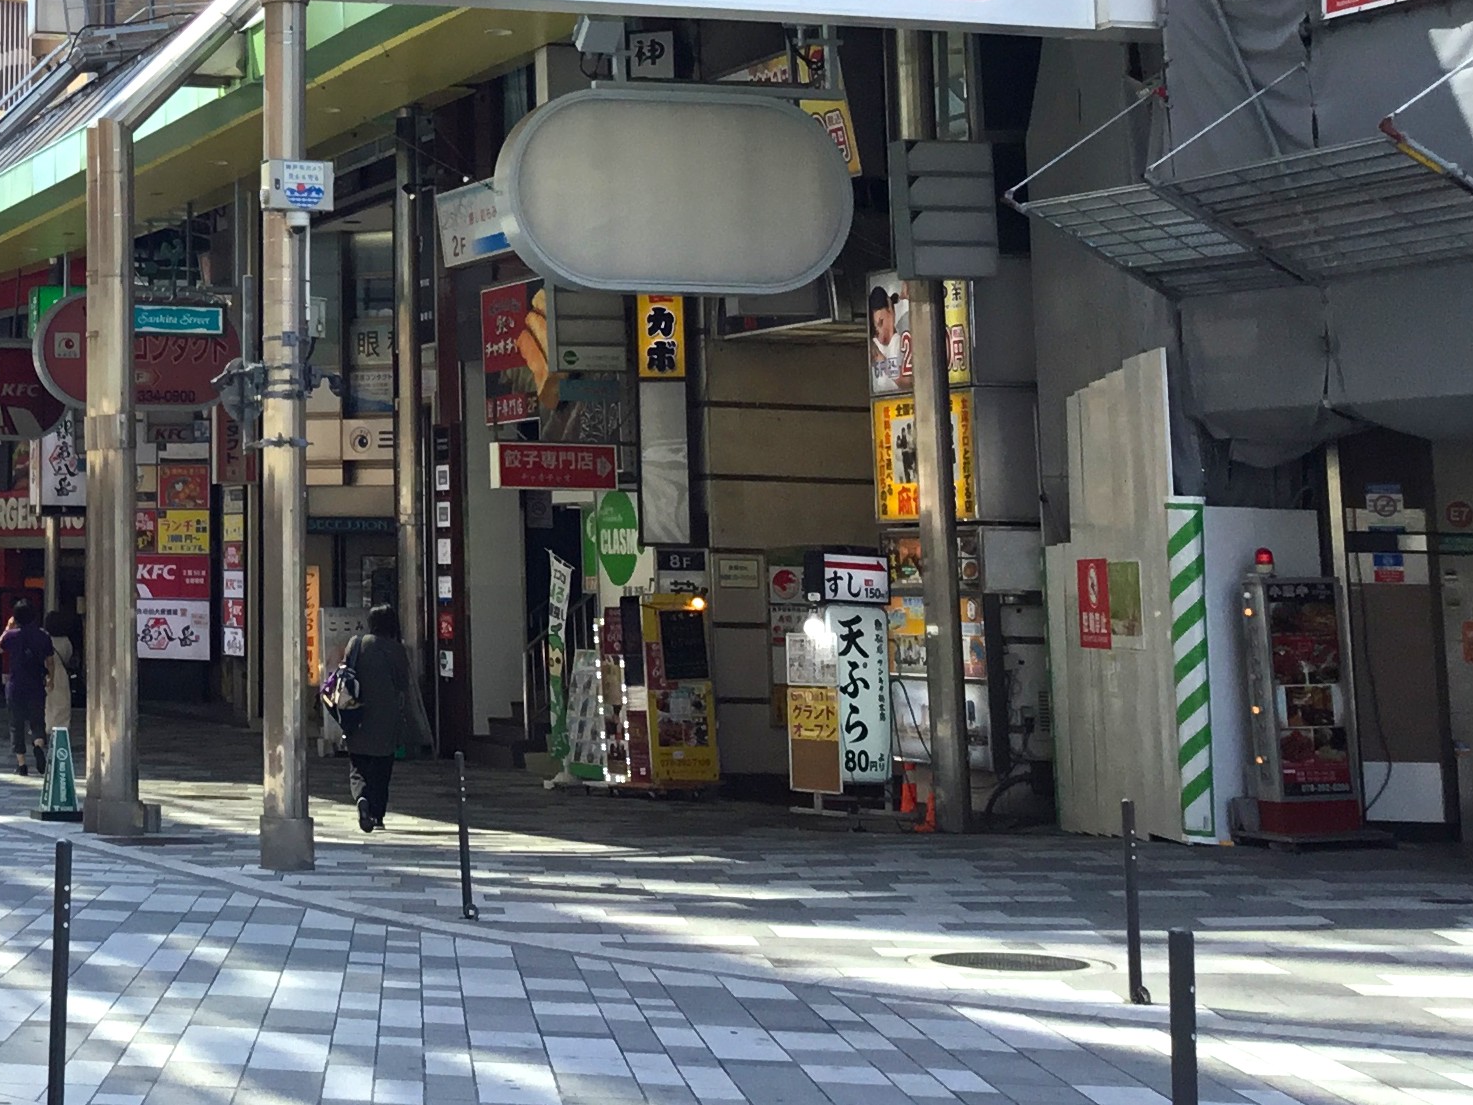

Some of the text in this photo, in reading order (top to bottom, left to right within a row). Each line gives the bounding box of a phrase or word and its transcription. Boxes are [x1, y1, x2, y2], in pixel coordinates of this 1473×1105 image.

[452, 235, 466, 257] 2F
[137, 310, 212, 326] Sankita Street
[1, 383, 40, 398] KFC
[154, 428, 188, 441] KFC
[504, 449, 594, 470] 餃子専門店
[160, 519, 193, 533] ランチ
[669, 554, 692, 569] 8F
[137, 564, 177, 580] KFC
[826, 570, 862, 599] すし
[838, 614, 870, 744] 天ぷら
[792, 704, 836, 721] グランド
[792, 723, 837, 738] オープン
[844, 749, 878, 773] 80円
